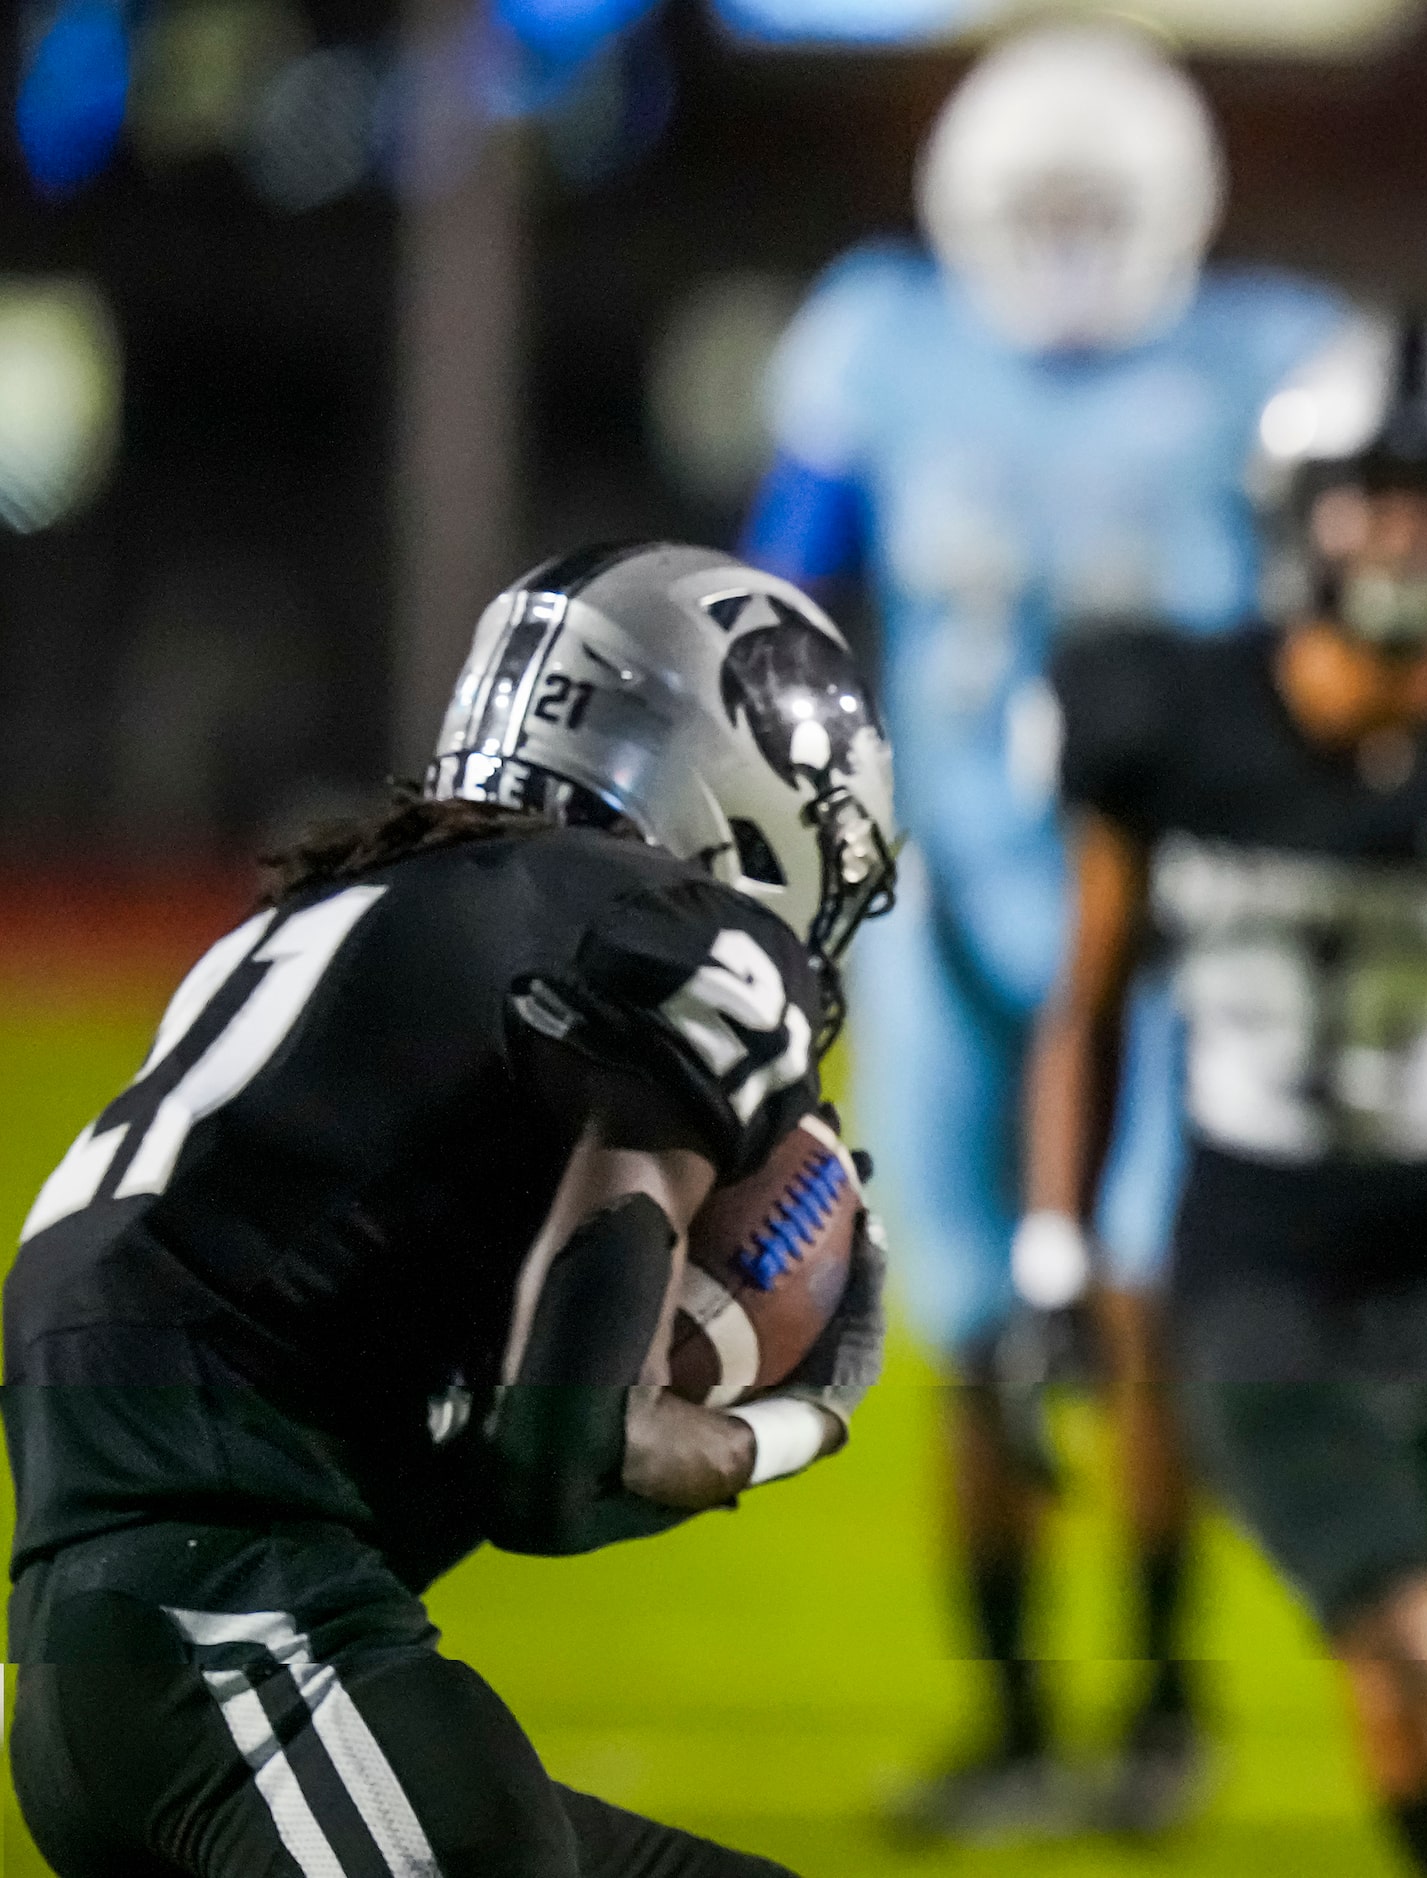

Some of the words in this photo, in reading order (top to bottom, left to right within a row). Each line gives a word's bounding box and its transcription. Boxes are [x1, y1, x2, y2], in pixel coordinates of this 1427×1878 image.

[534, 671, 596, 730] 21
[18, 884, 390, 1244] 21
[658, 928, 812, 1128] 21
